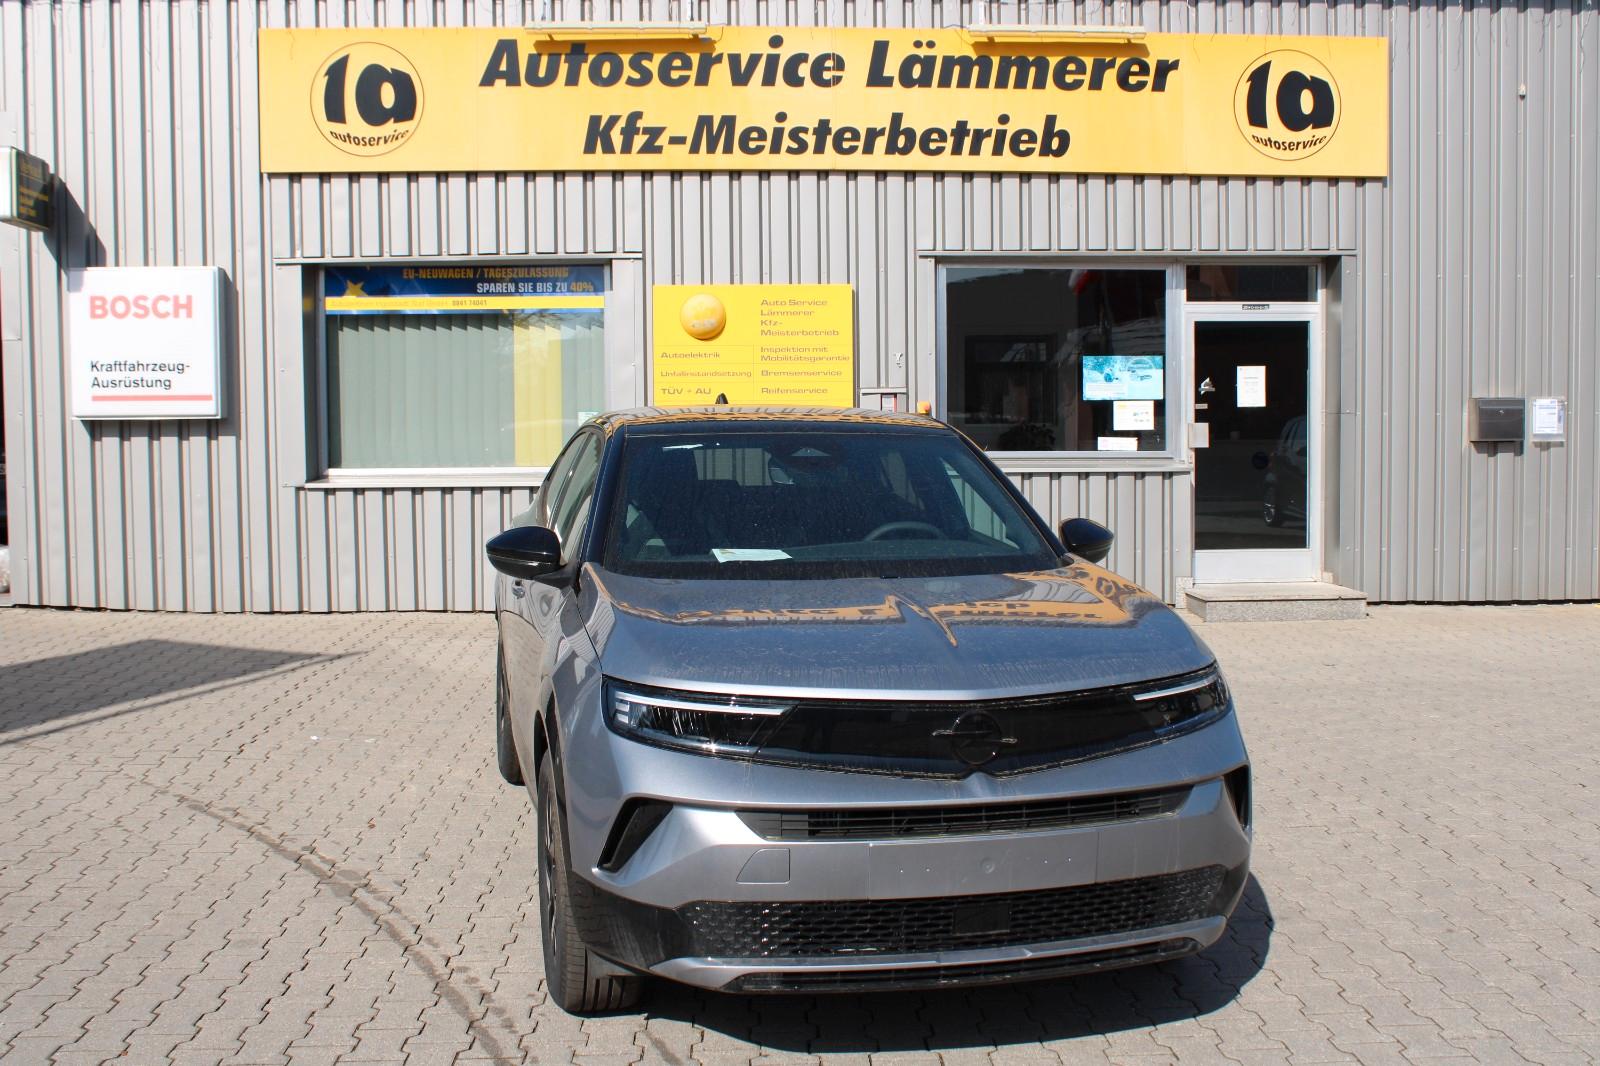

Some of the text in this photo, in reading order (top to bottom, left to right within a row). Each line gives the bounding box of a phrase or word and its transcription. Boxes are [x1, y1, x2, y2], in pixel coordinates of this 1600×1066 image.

[478, 35, 1179, 93] Autoservice Lämmerer
[323, 53, 418, 127] 1a
[1245, 59, 1335, 133] 1a
[329, 128, 410, 147] autoservice
[583, 111, 1071, 158] Kfz-Meisterbetrieb
[1251, 134, 1327, 152] autoservice
[403, 268, 473, 279] EU-NEUWAGEN
[484, 267, 569, 278] TAGESZULASSUNG
[477, 281, 594, 293] SPAREN SIE BIS ZU 40%
[89, 295, 193, 319] BOSCH
[760, 309, 815, 317] Lämmerer
[760, 329, 839, 337] Meisterbetrieb
[760, 346, 810, 354] Inspektion
[760, 354, 850, 363] Mobilitätsgarantie
[90, 360, 190, 374] Kraftfahrzeug-
[761, 369, 842, 377] Bremsenservice
[660, 370, 752, 378] Unfallinstandsetzung
[90, 376, 172, 390] Ausrüstung
[660, 386, 684, 395] TÜV
